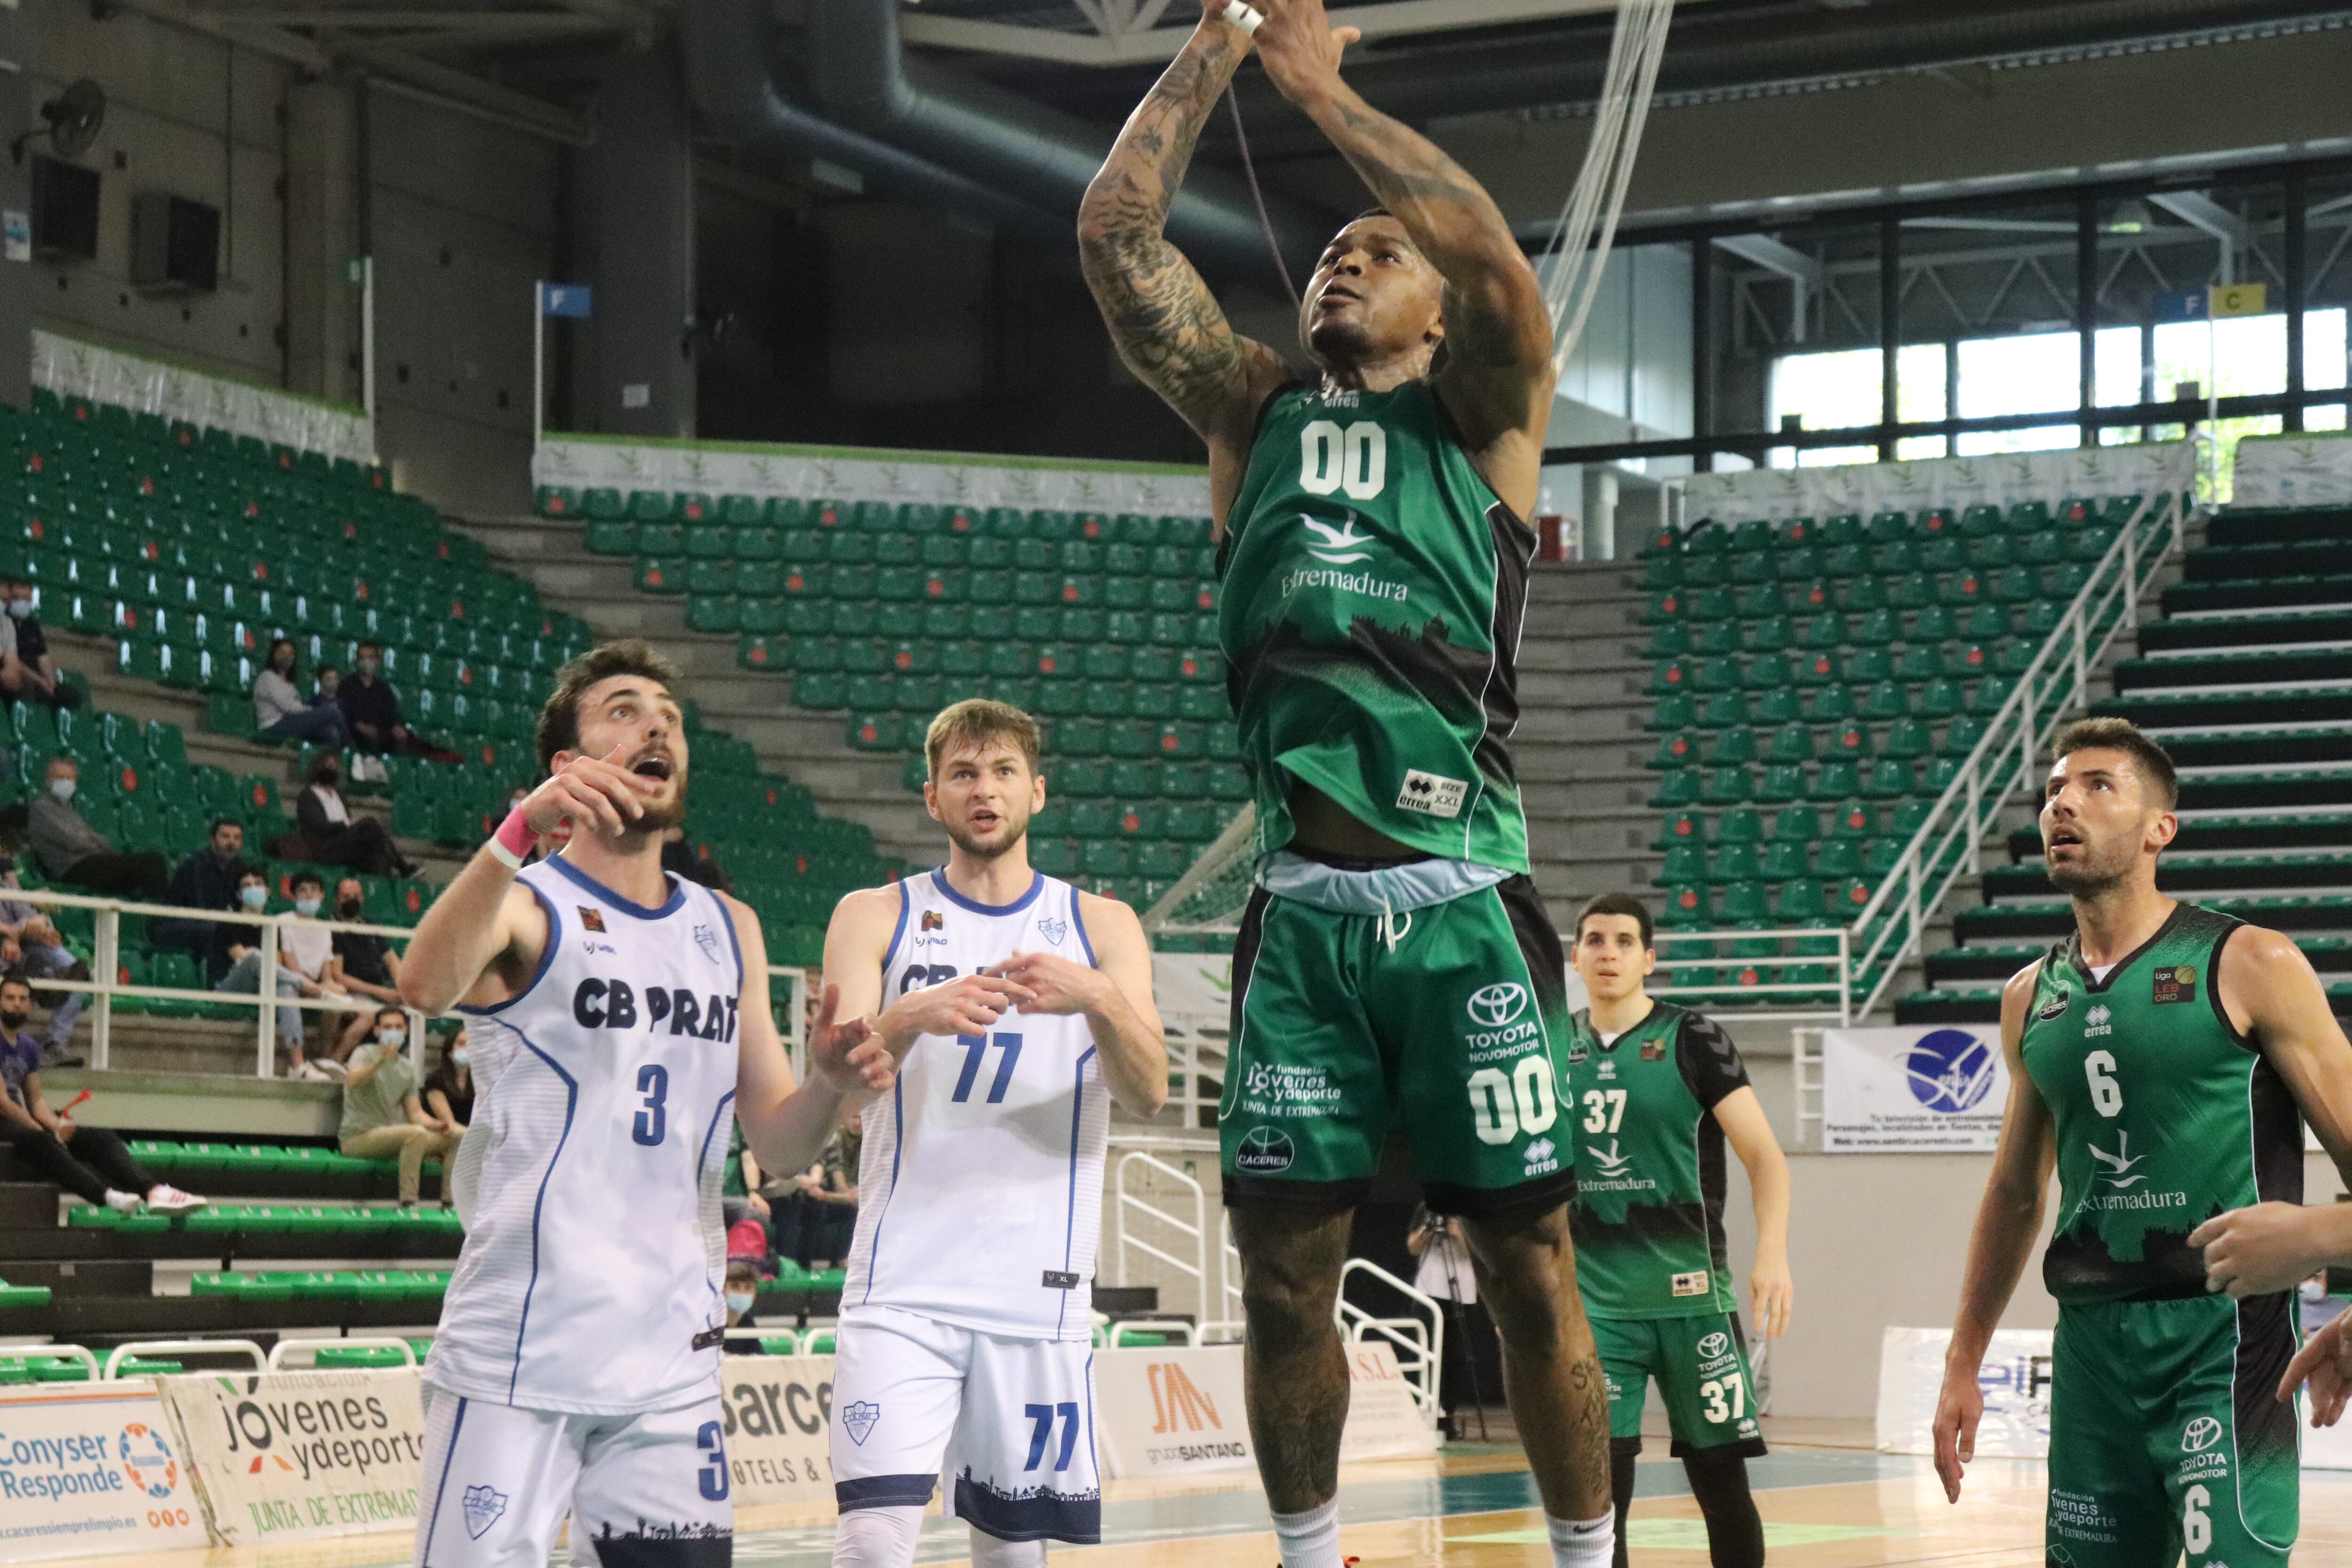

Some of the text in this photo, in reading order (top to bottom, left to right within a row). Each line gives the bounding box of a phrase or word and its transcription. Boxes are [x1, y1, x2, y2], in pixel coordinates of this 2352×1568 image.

[2225, 293, 2239, 309] C
[1300, 420, 1386, 500] 00
[1399, 795, 1431, 810] errea
[2155, 972, 2171, 981] Liga
[2155, 984, 2179, 994] LEB
[573, 978, 739, 1044] CB PRAT
[2155, 994, 2177, 1002] ORO
[1466, 1021, 1538, 1049] TOYOTA
[1469, 1038, 1540, 1063] NOVOMOTOR
[2084, 1025, 2112, 1038] errea
[951, 1032, 1023, 1104] 77
[2084, 1050, 2123, 1117] 6
[632, 1064, 668, 1146] 3
[1467, 1054, 1557, 1146] 00
[1583, 1089, 1627, 1133] 37
[1525, 1158, 1558, 1177] errea
[1577, 1178, 1656, 1192] Extremadura
[1698, 1353, 1736, 1372] TOYOTA
[1700, 1372, 1744, 1424] 37
[1024, 1402, 1080, 1472] 77
[697, 1421, 729, 1502] 3
[2180, 1453, 2227, 1473] TOYOTA
[0, 1463, 124, 1502] Responde
[247, 1499, 304, 1536] JUNTA
[306, 1496, 334, 1527] DE
[2183, 1484, 2212, 1555] 6
